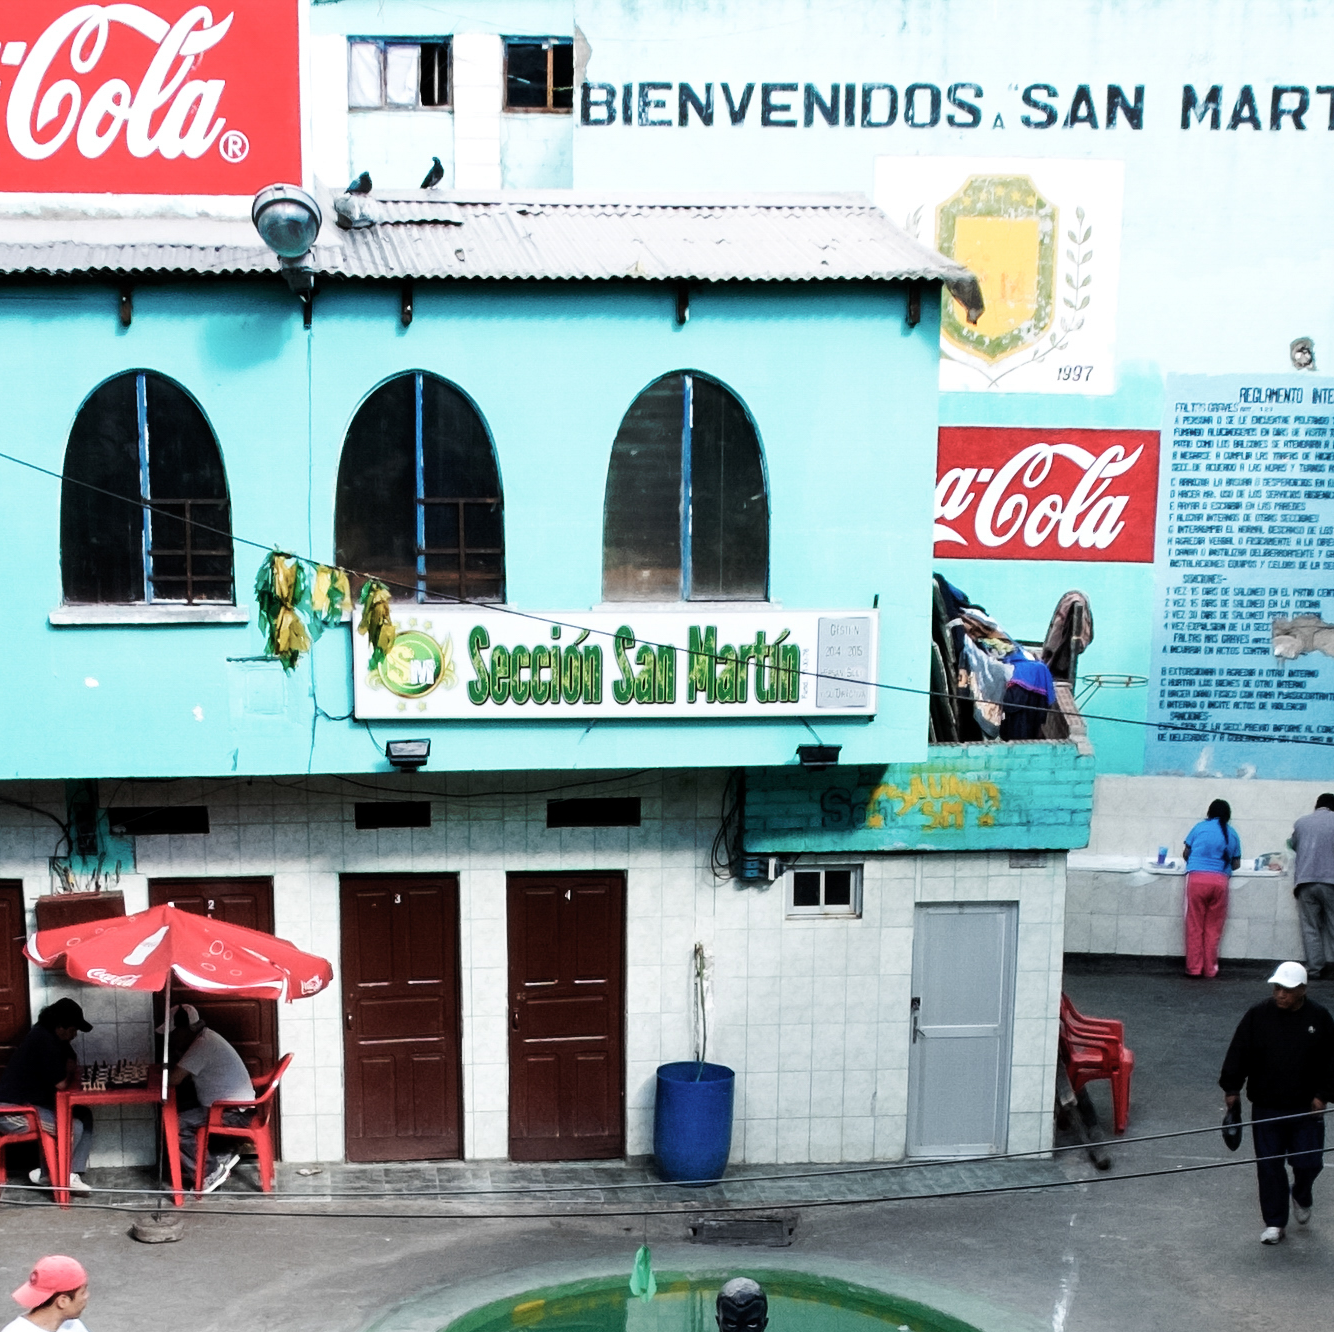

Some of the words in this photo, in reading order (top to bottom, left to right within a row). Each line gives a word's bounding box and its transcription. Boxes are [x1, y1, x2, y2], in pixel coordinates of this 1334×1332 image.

[579, 82, 984, 130] BIENVENIDOS
[1057, 365, 1094, 381] 1997
[1239, 387, 1303, 404] REGLAMENTO
[467, 624, 603, 704] Sección
[612, 625, 677, 704] San
[687, 625, 800, 704] Martín
[208, 900, 215, 910] 2
[394, 893, 401, 904] 3
[86, 968, 142, 988] Coca-Cola
